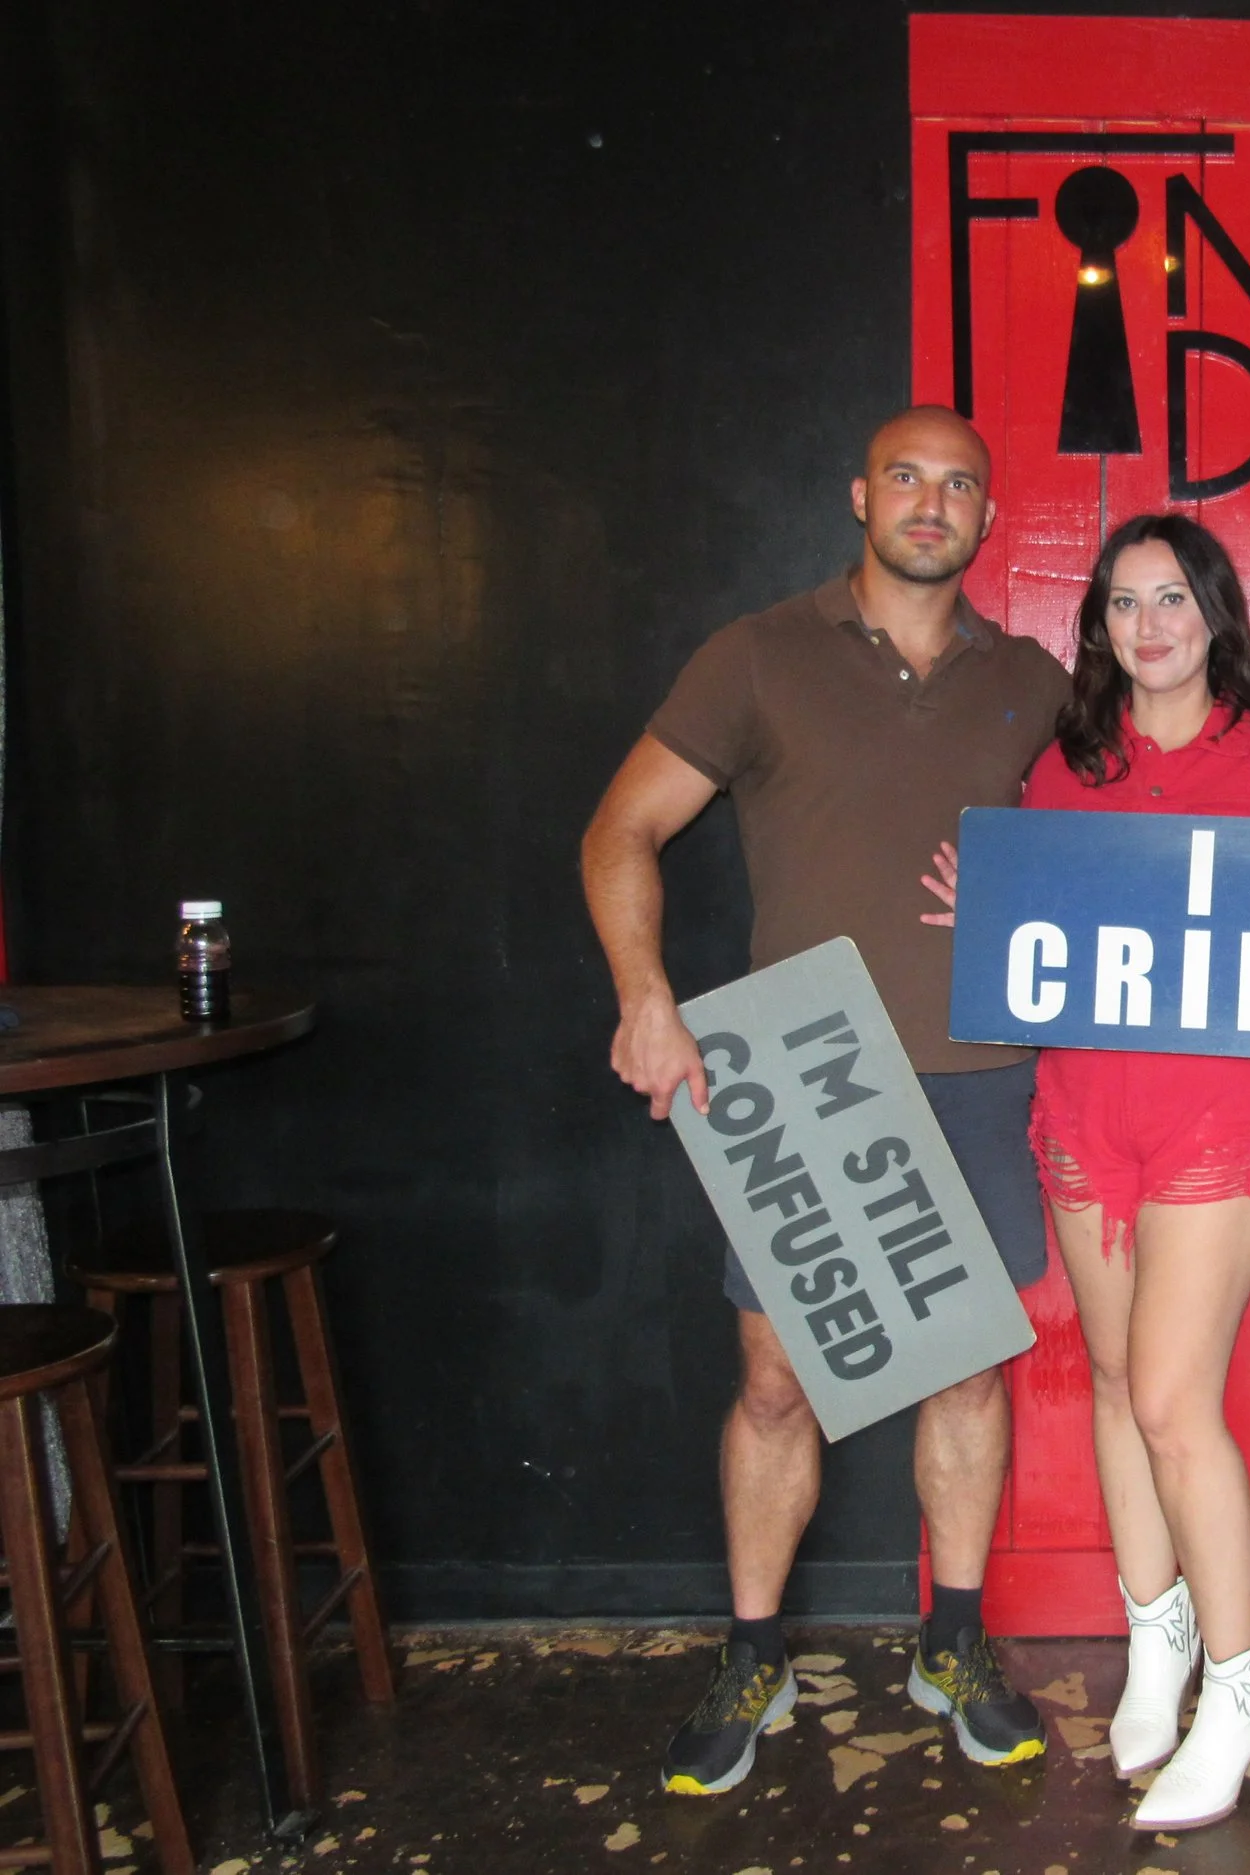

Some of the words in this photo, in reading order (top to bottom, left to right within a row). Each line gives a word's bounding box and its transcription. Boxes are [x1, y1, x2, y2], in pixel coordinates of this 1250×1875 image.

[1187, 830, 1215, 916] I
[699, 1031, 893, 1381] CONFUSED
[782, 1010, 883, 1120] I'M
[842, 1136, 969, 1322] STILL
